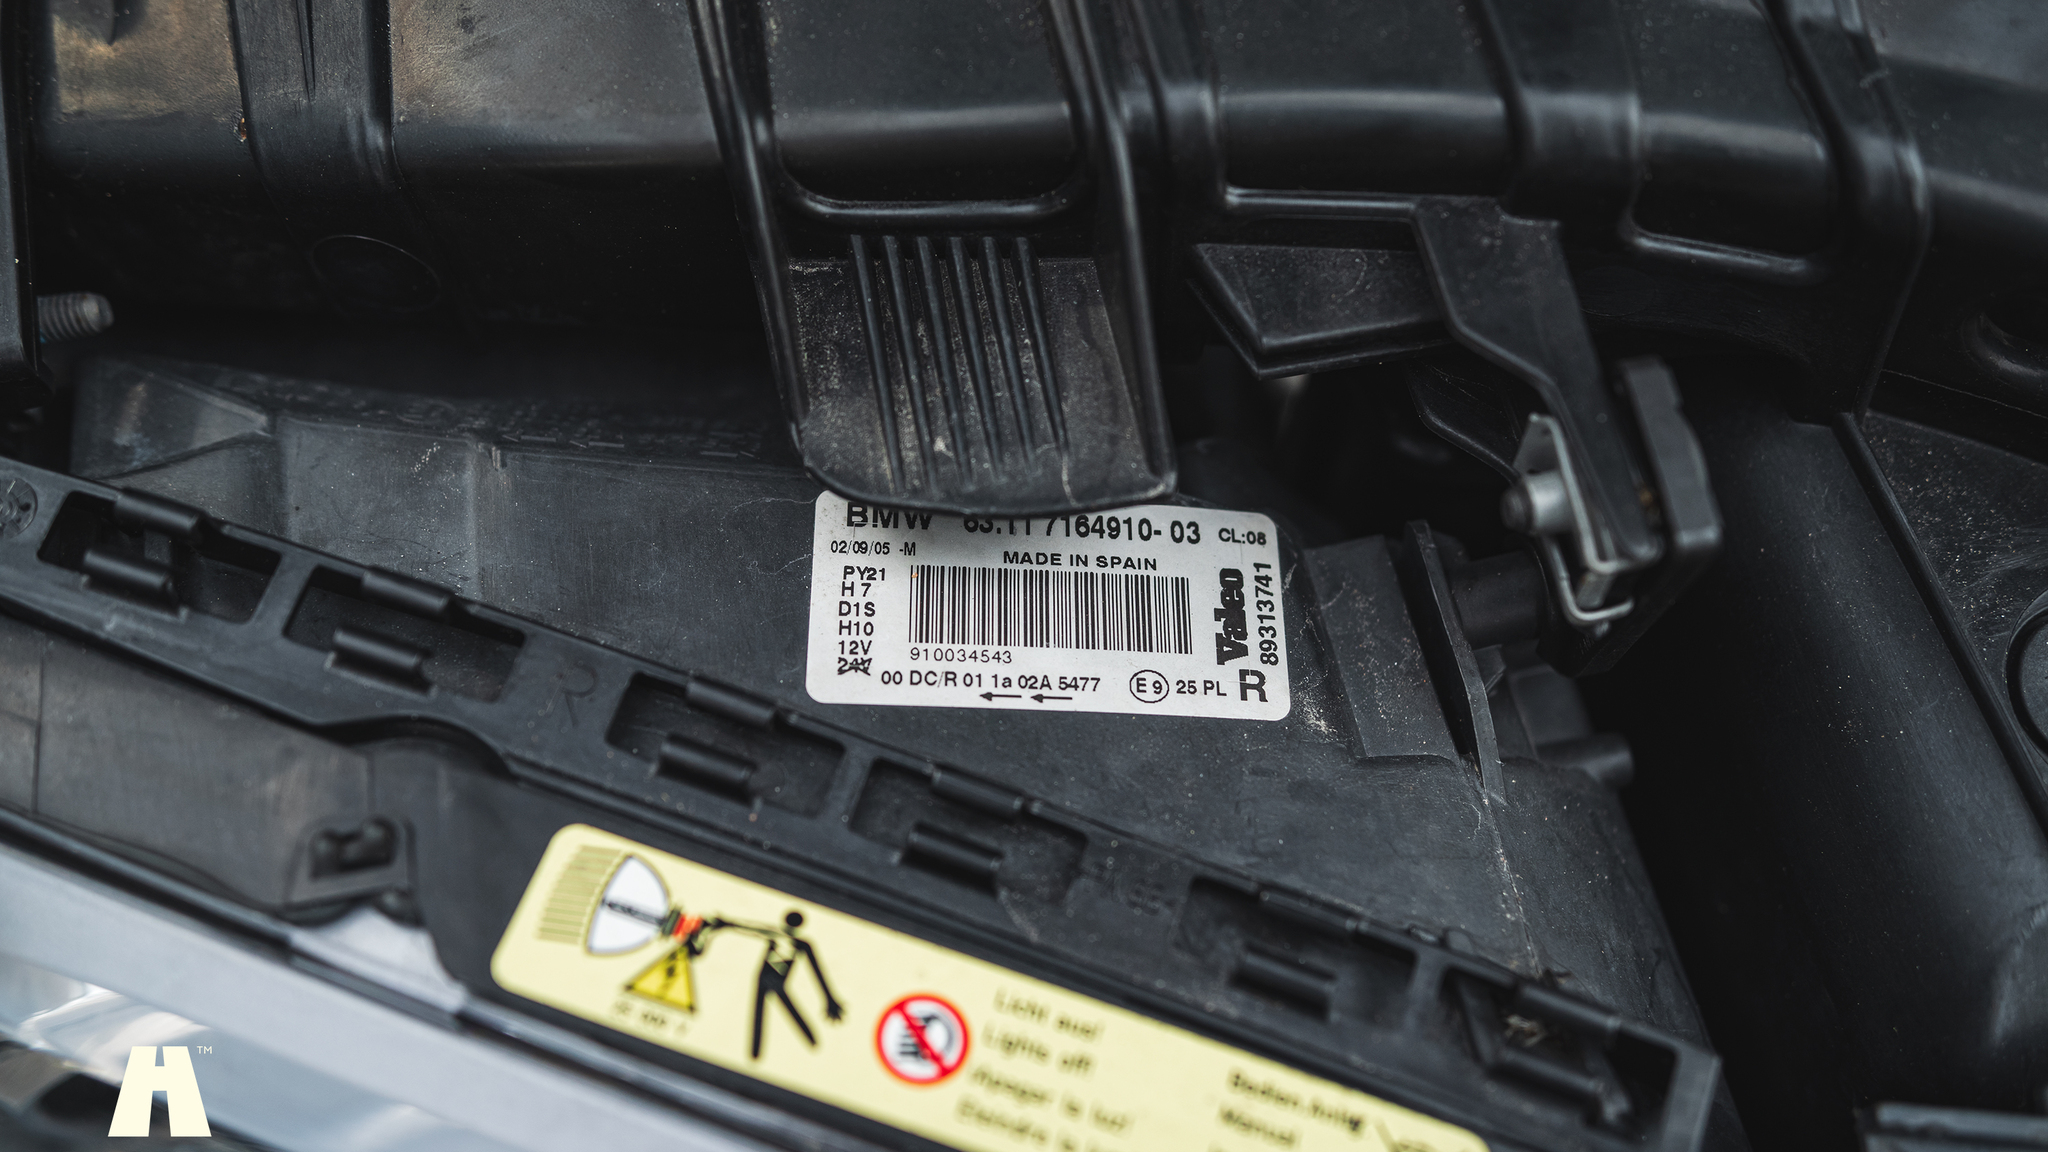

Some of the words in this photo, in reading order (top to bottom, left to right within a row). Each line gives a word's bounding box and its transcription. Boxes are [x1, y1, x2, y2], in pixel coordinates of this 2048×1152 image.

[847, 502, 933, 530] BMW
[1170, 519, 1201, 544] 03
[1218, 527, 1267, 546] CL:08
[830, 540, 890, 556] 02/09/05
[1003, 550, 1062, 566] MADE
[1070, 554, 1089, 568] IN
[1096, 555, 1157, 571] SPAIN
[842, 565, 886, 581] PY21
[838, 600, 876, 617] D1S
[1214, 567, 1249, 666] Valeo
[1252, 562, 1279, 667] 89313741
[838, 620, 874, 636] H10
[838, 639, 873, 655] 12V
[909, 647, 1012, 664] 910034543
[881, 670, 903, 685] 00
[909, 669, 957, 688] DC/R
[963, 673, 982, 688] 01
[991, 673, 1012, 689] 1a
[1017, 674, 1052, 691] 02A
[1058, 676, 1101, 692] 5477
[1176, 679, 1197, 695] 25
[1203, 679, 1227, 697] PL
[1239, 669, 1268, 702] R
